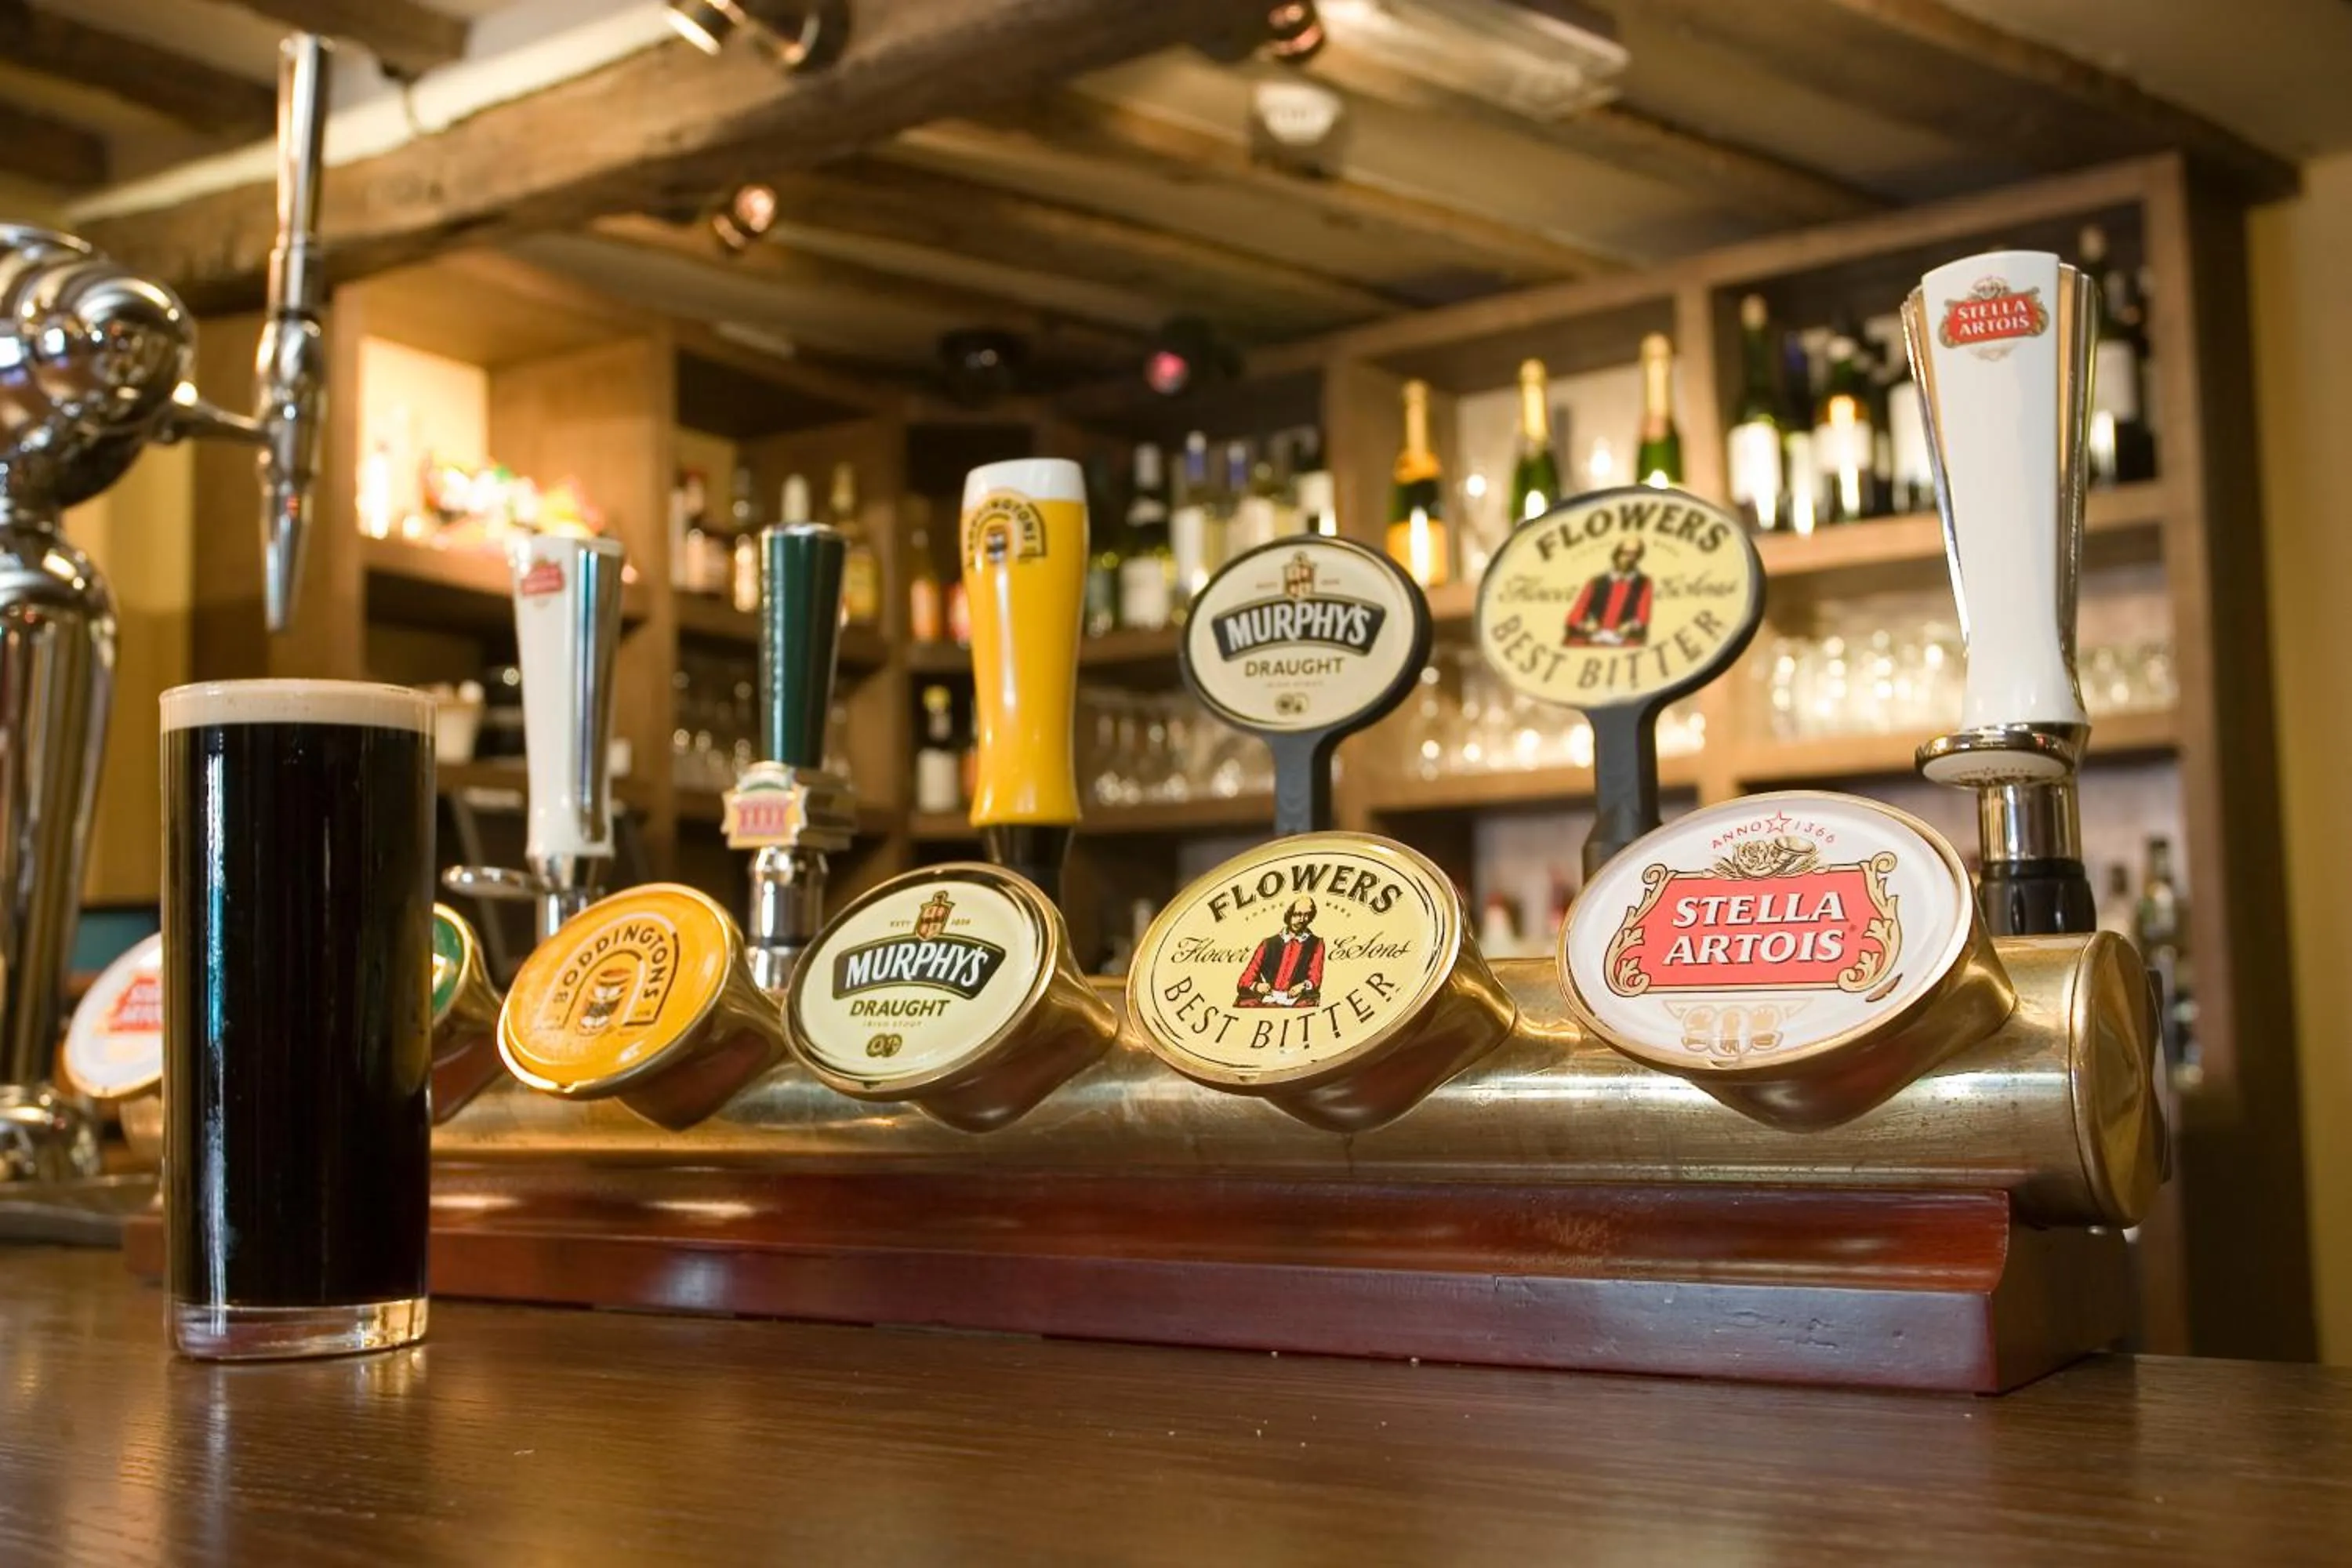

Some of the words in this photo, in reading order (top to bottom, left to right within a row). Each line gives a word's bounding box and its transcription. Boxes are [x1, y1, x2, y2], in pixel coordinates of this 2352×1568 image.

[1958, 299, 2027, 319] STELLA
[1960, 315, 2030, 336] ARTOIS
[1534, 502, 1731, 563] FLOWERS
[1244, 657, 1345, 679] DRAUGHT
[1491, 614, 1568, 684] BEST
[1577, 609, 1724, 690] BITTER
[1711, 821, 1762, 849] ANNO
[1794, 821, 1835, 844] 1366
[1207, 863, 1404, 924] FLOWERS
[1671, 891, 1849, 928] STELLA
[554, 924, 669, 1004] BODDINGTONS
[1662, 929, 1845, 967] ARTOIS
[849, 999, 951, 1018] DRAUGHT
[1164, 975, 1240, 1044] BEST
[1250, 971, 1396, 1051] BITTER
